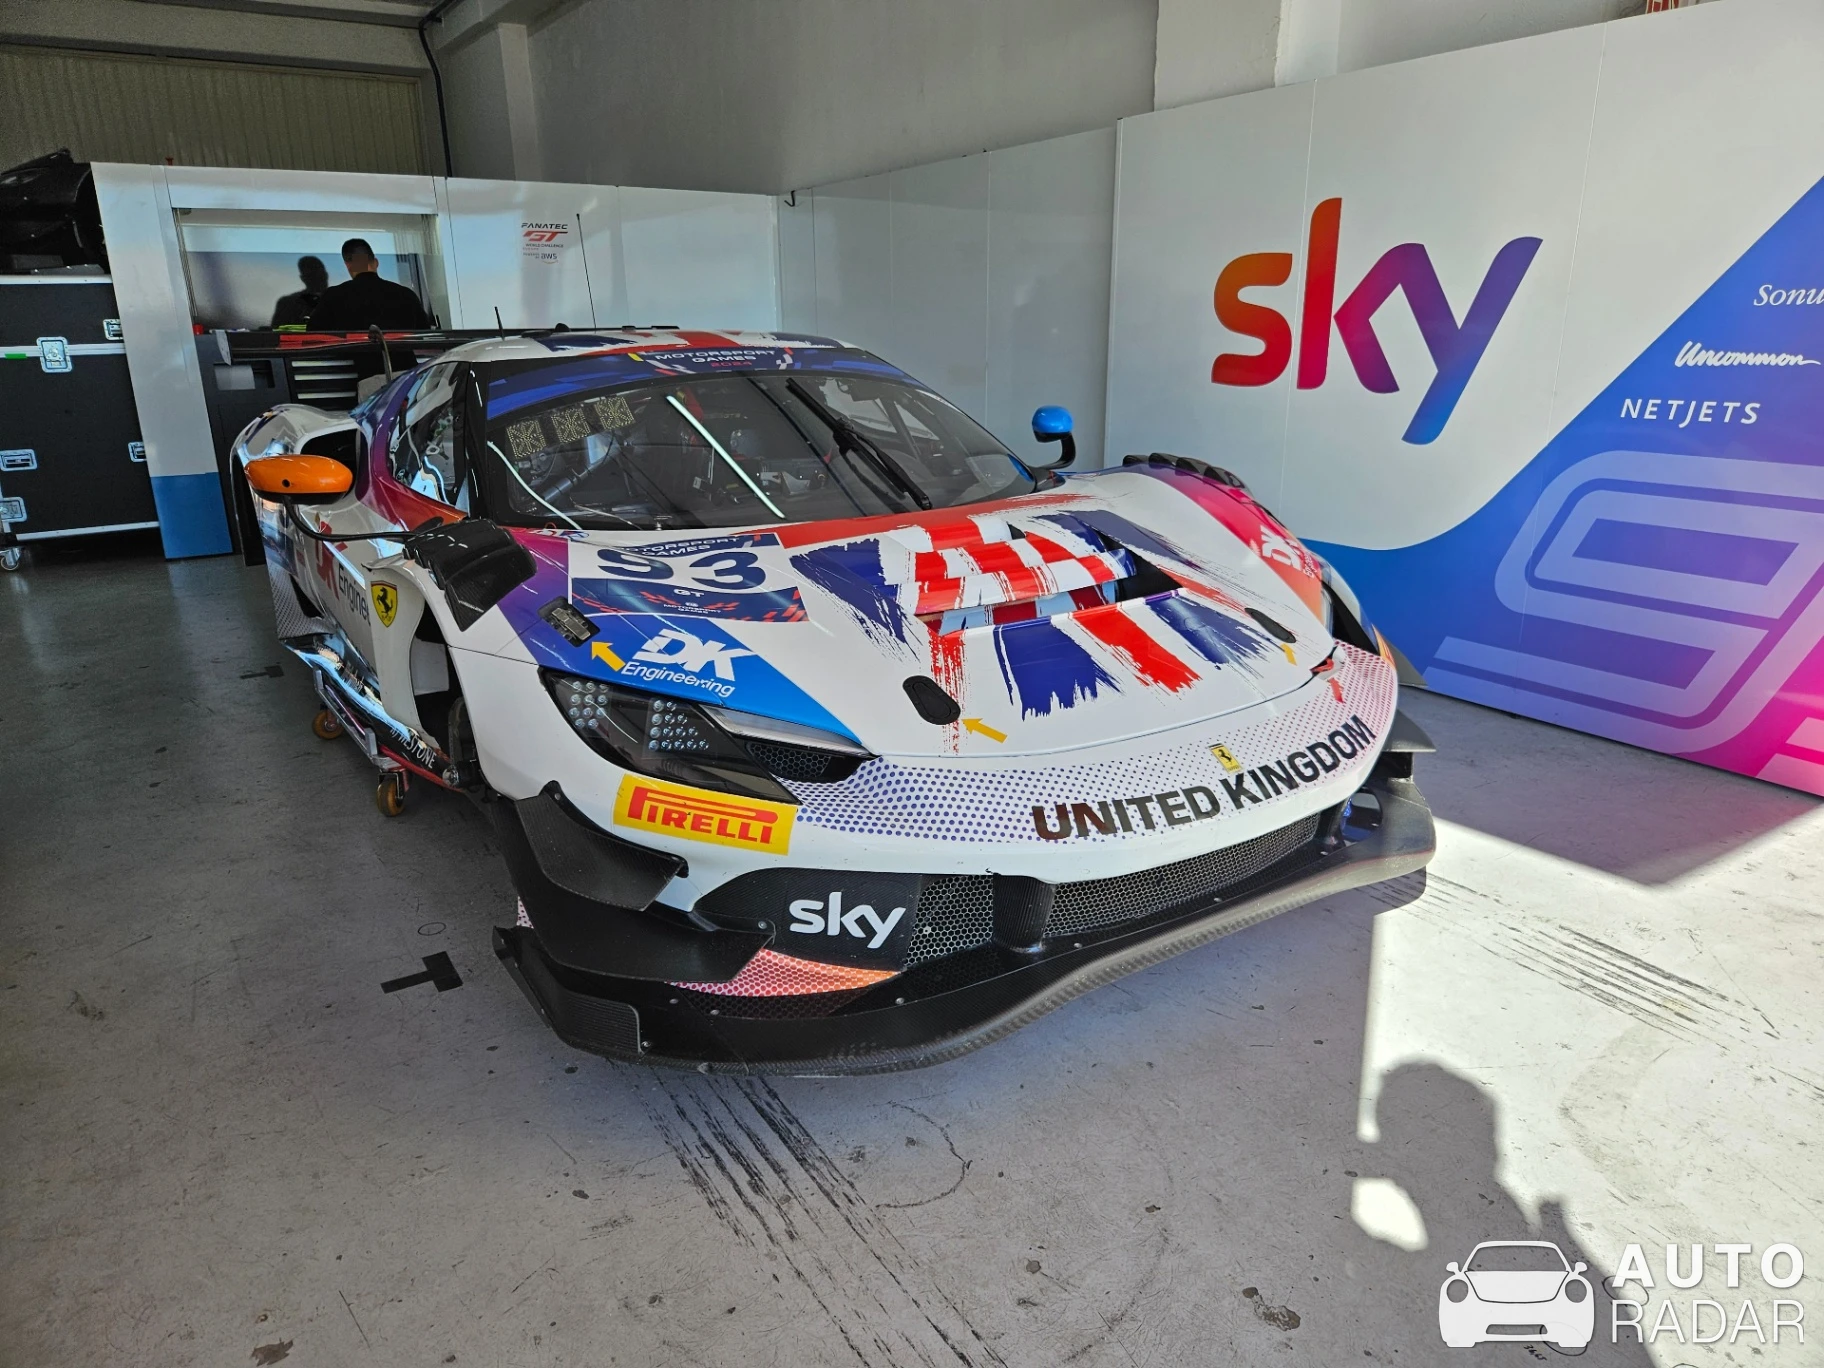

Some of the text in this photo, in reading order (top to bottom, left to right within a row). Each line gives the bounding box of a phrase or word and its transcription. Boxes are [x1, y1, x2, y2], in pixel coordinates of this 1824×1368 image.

[521, 222, 568, 230] FANATEC
[540, 252, 558, 260] aws
[1210, 197, 1544, 446] sky
[654, 350, 776, 361] MOTORSPORT
[691, 355, 757, 363] GAMES
[1674, 340, 1822, 368] Uncommon
[1619, 398, 1761, 429] NETJETS
[641, 544, 711, 556] GAMES
[673, 588, 705, 598] GT
[632, 628, 759, 682] DK
[621, 661, 736, 697] Engineering
[1032, 714, 1378, 842] UNITED KINGDOM
[627, 786, 779, 845] PIRELLI
[788, 891, 907, 950] sky
